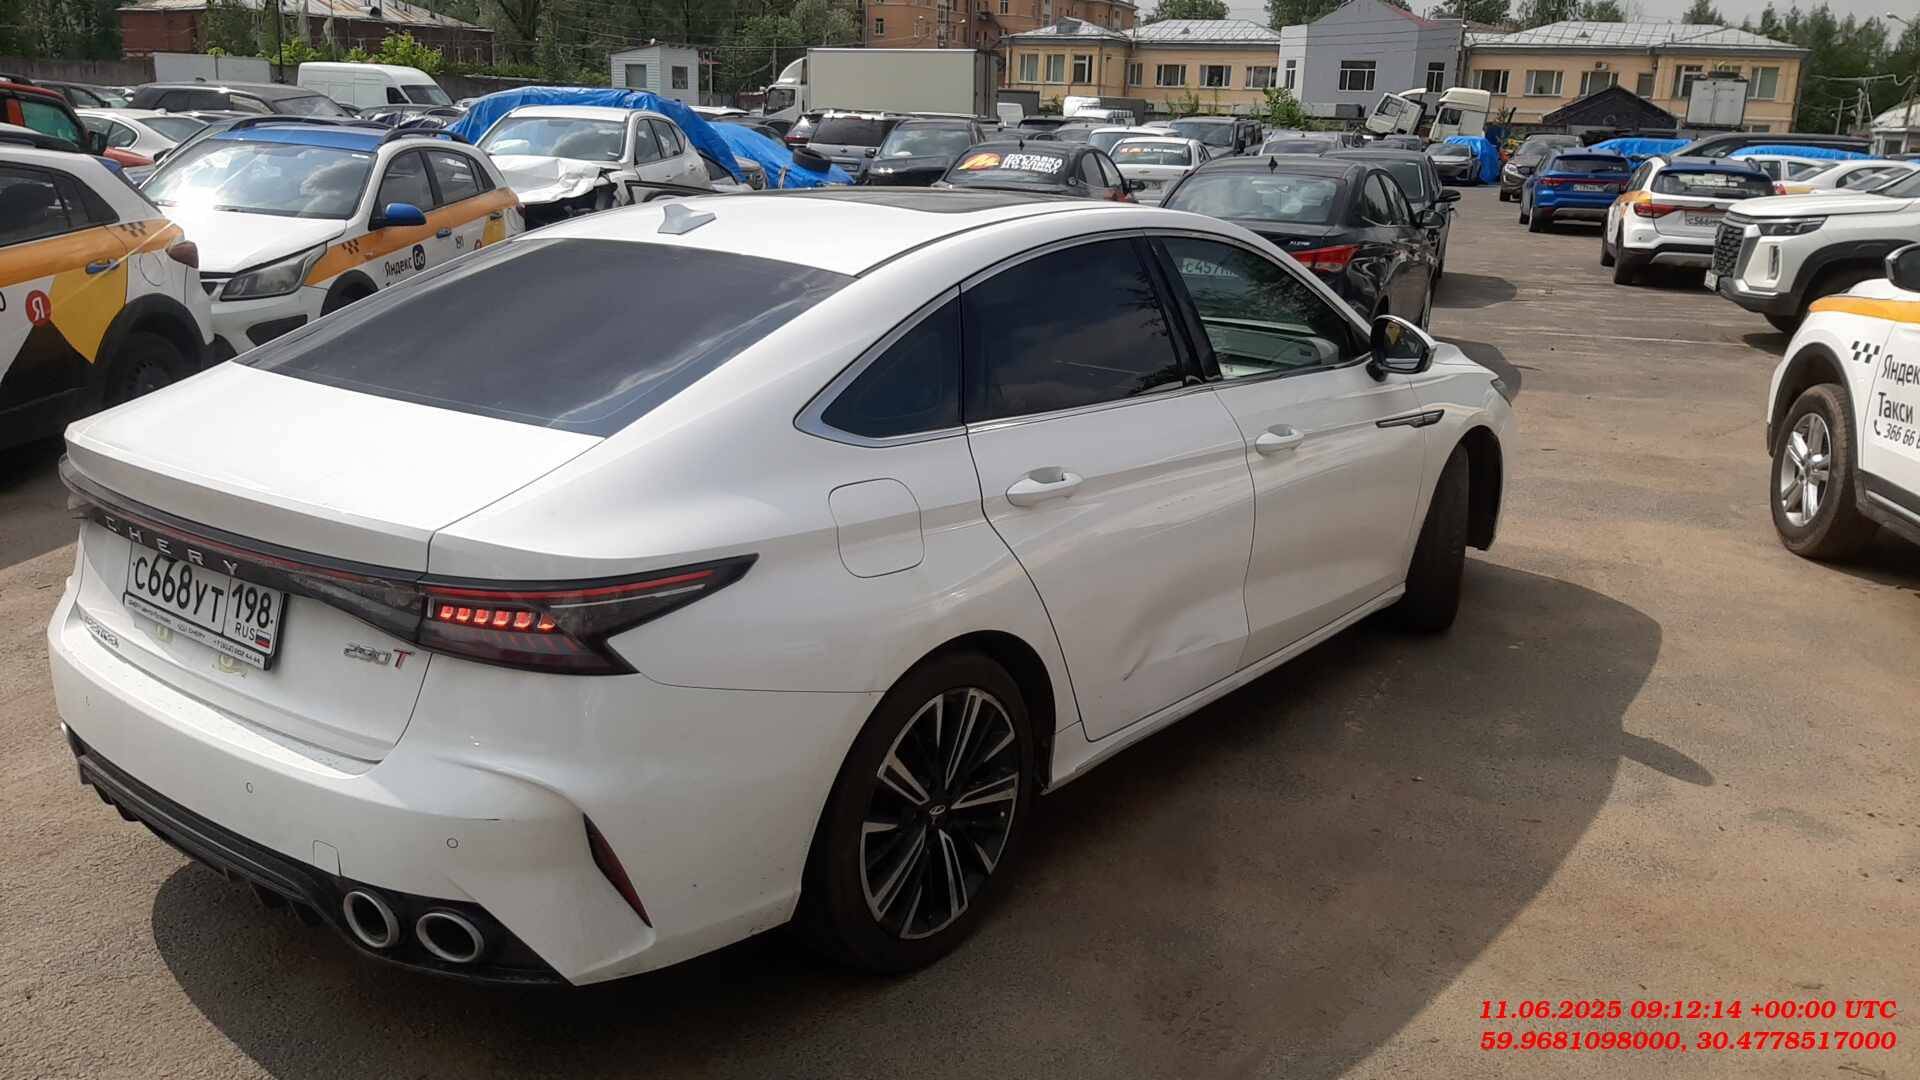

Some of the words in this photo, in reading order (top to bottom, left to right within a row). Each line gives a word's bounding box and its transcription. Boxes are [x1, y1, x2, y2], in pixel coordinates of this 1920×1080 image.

[384, 257, 412, 277] Яндекс
[31, 296, 46, 322] Я
[1878, 391, 1914, 425] Такси
[1883, 423, 1902, 442] 366
[1902, 428, 1916, 446] 66
[105, 516, 239, 576] CHERY
[231, 583, 273, 630] 198
[234, 622, 256, 641] RUS
